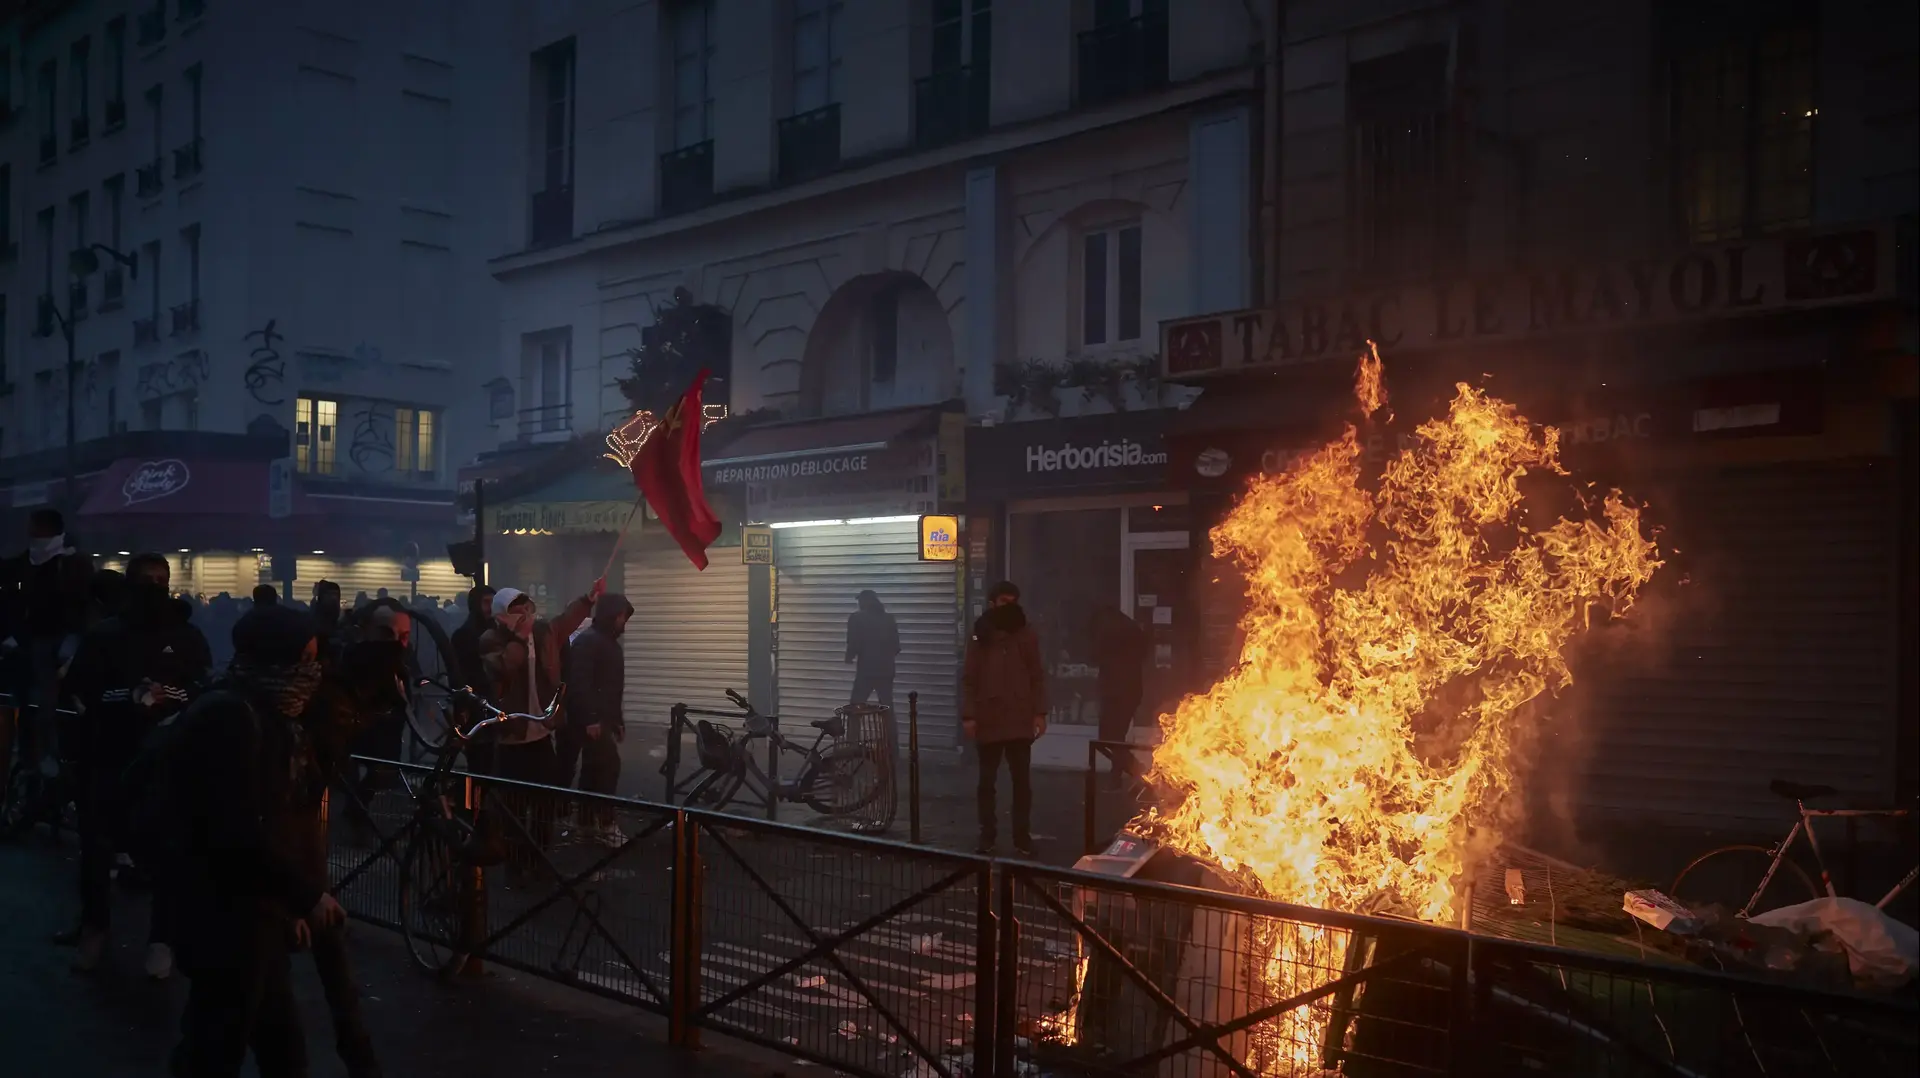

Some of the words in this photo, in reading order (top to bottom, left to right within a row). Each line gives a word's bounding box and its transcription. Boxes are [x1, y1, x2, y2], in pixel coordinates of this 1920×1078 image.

[1234, 297, 1404, 362] TABAC
[1435, 281, 1503, 338] LE
[1529, 247, 1766, 330] MAYOL
[715, 463, 790, 484] RÉPARATION
[791, 456, 868, 477] DÉBLOCAGE
[1026, 438, 1168, 472] Herborisia.com
[930, 528, 949, 542] Ria
